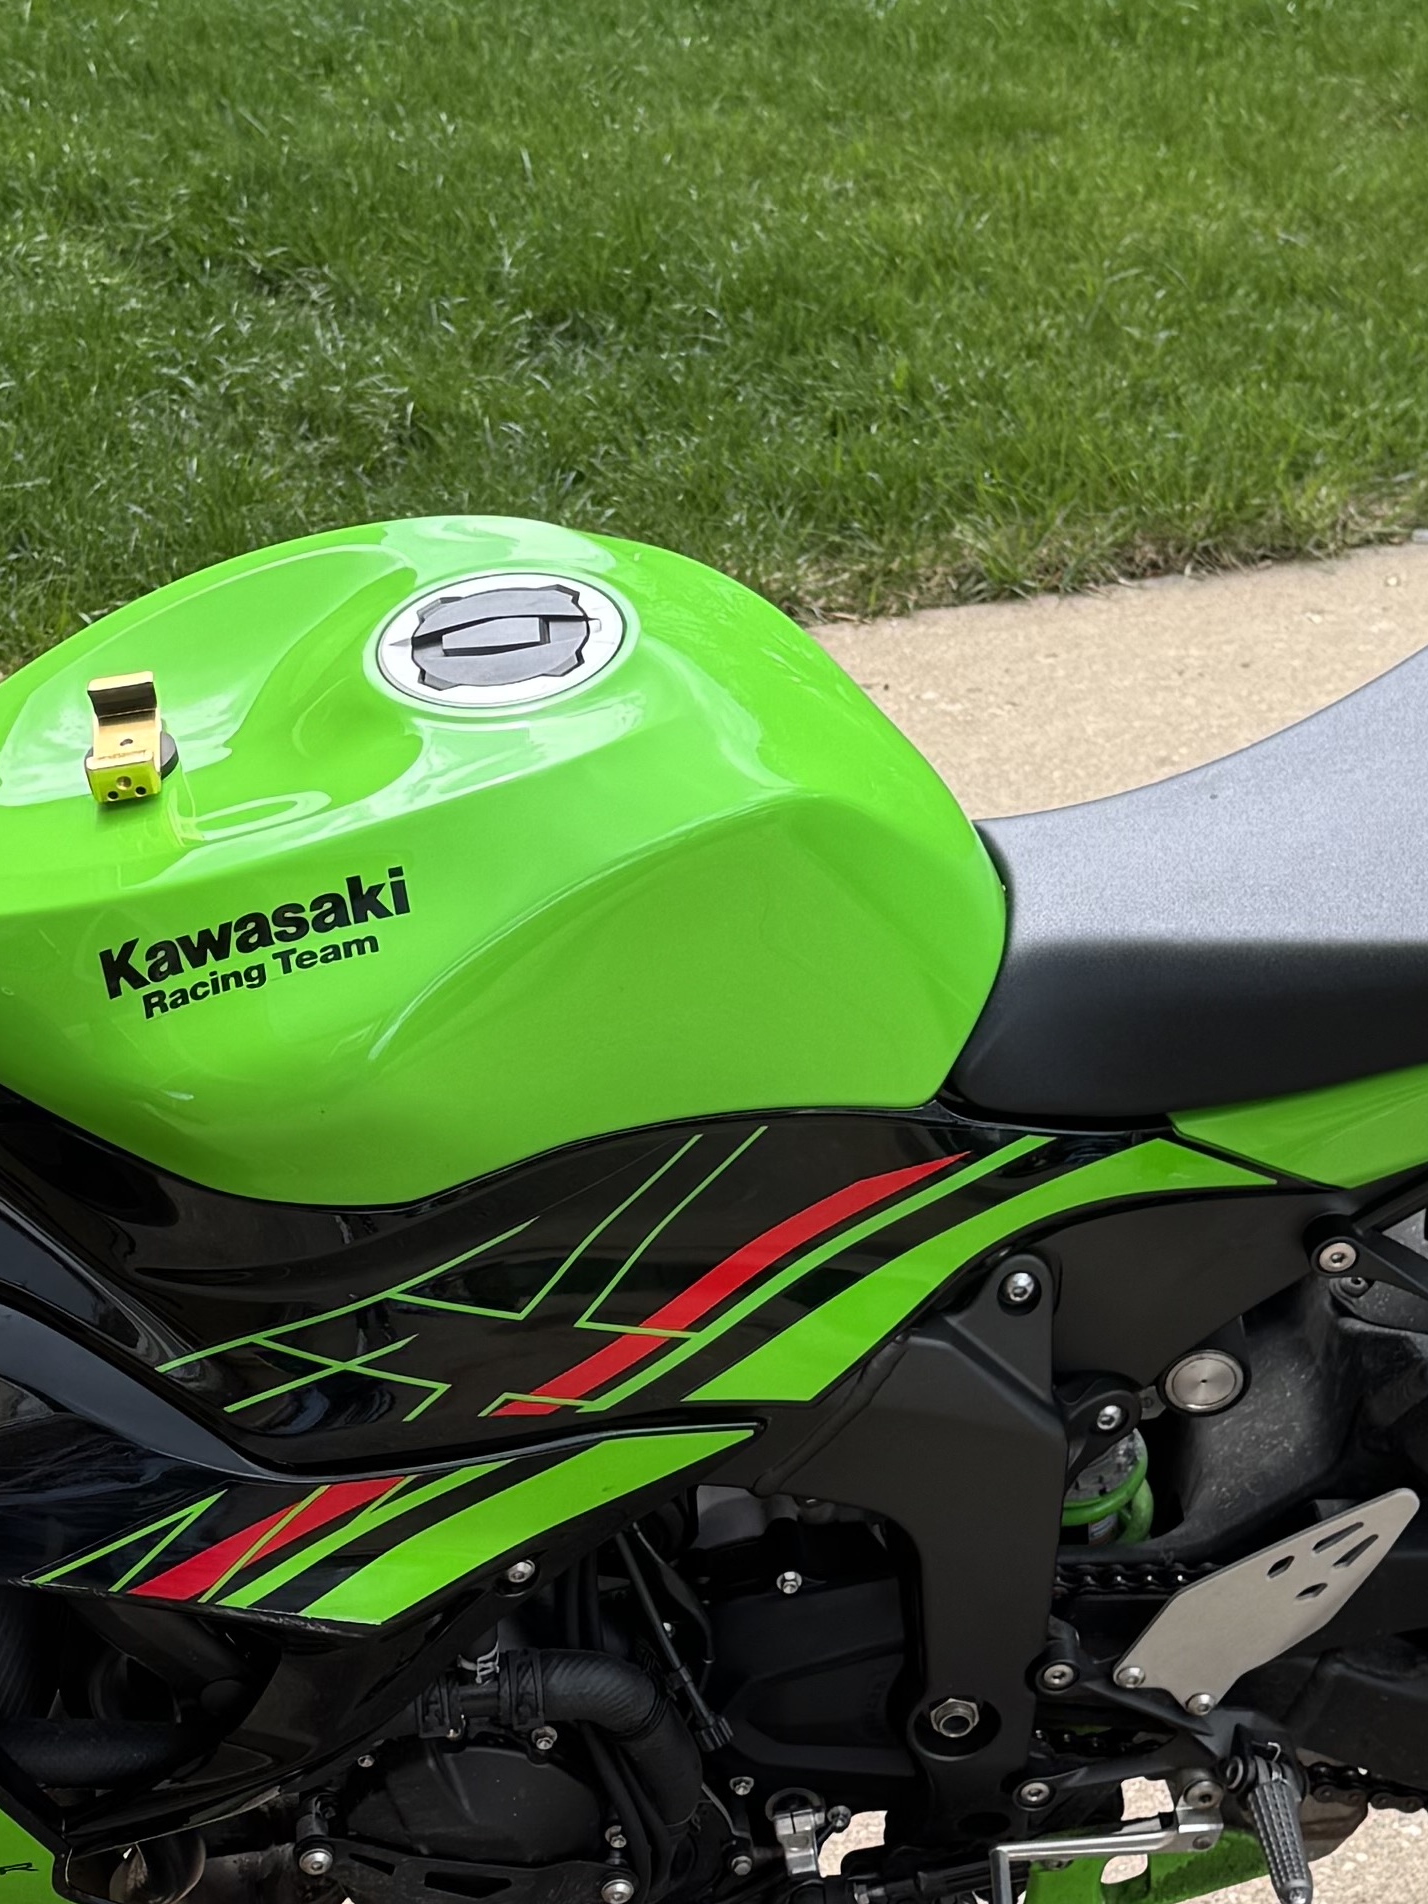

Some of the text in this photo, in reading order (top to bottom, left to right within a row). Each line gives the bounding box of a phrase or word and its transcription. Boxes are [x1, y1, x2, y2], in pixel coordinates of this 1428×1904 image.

[99, 866, 410, 999] Kawasaki
[142, 934, 379, 1020] Racing Team
